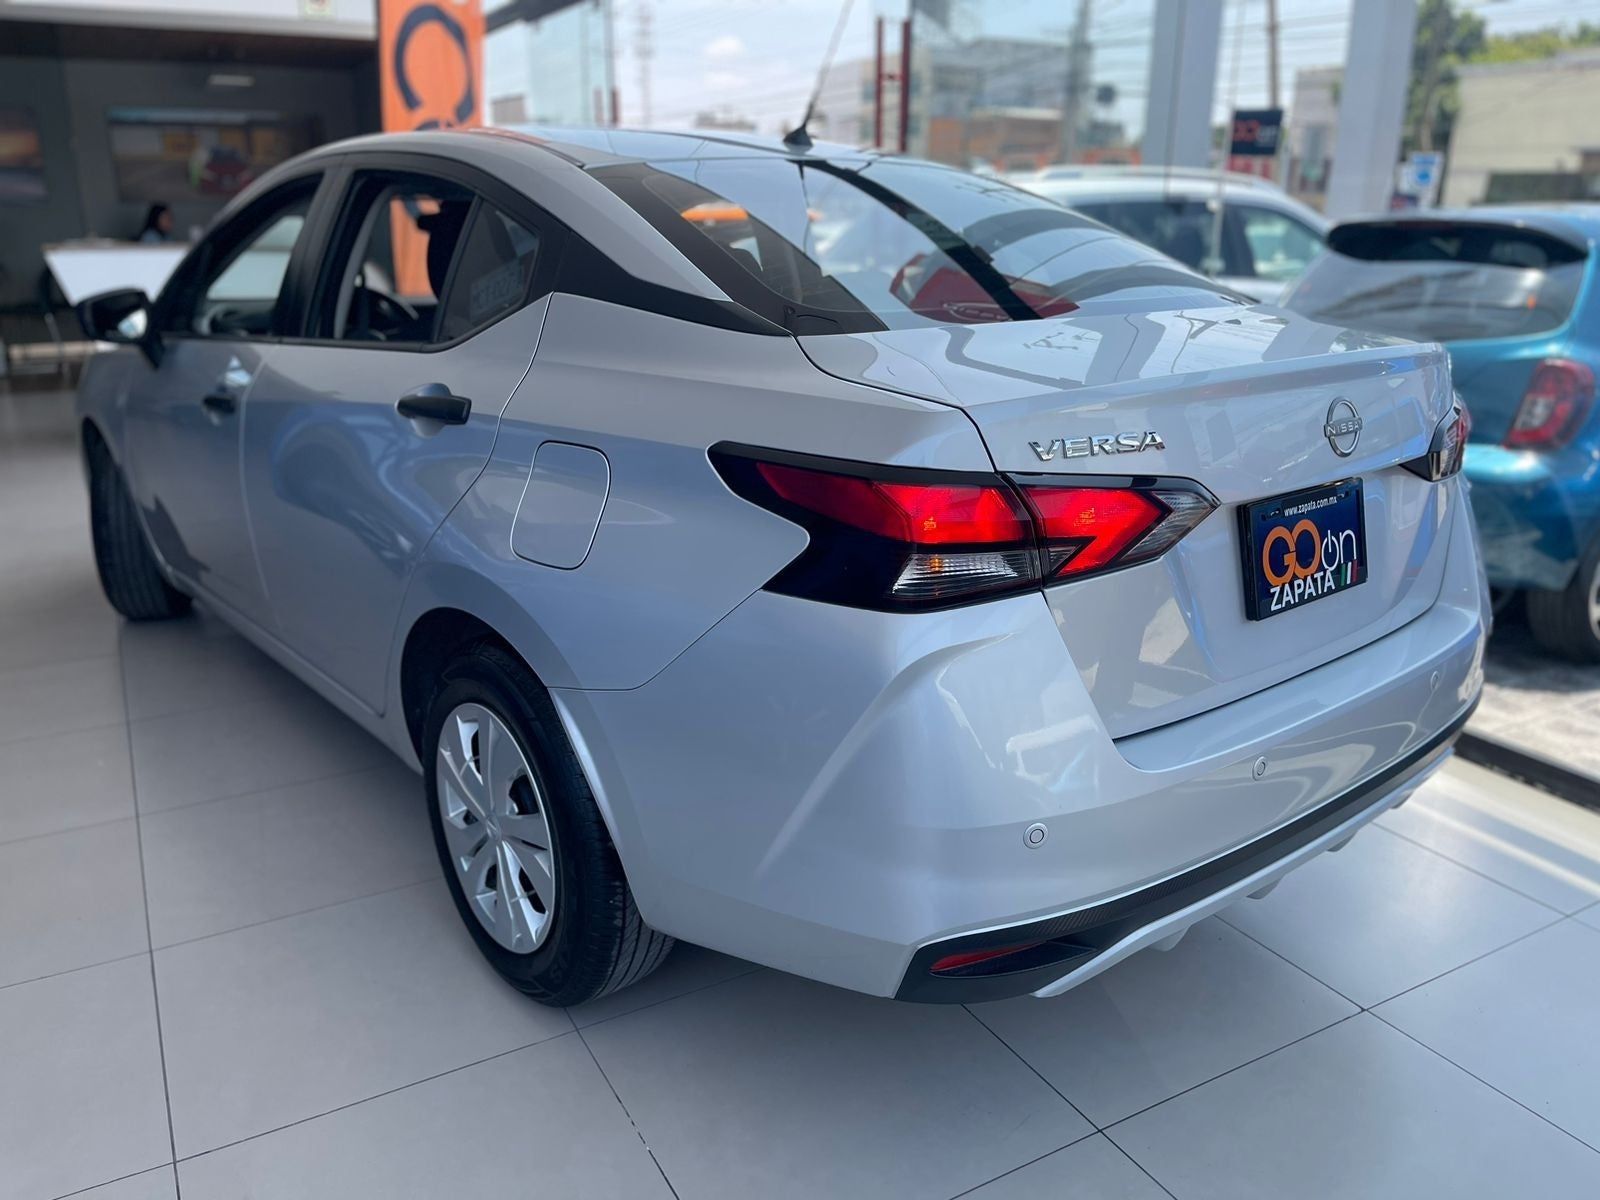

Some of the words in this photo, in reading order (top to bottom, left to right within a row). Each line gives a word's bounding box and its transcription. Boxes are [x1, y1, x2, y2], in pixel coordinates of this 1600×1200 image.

[1327, 420, 1361, 436] NISSA
[1028, 431, 1165, 461] VERSA
[1283, 496, 1338, 517] www.zapata.com.mx
[1269, 569, 1336, 611] ZAPATA
